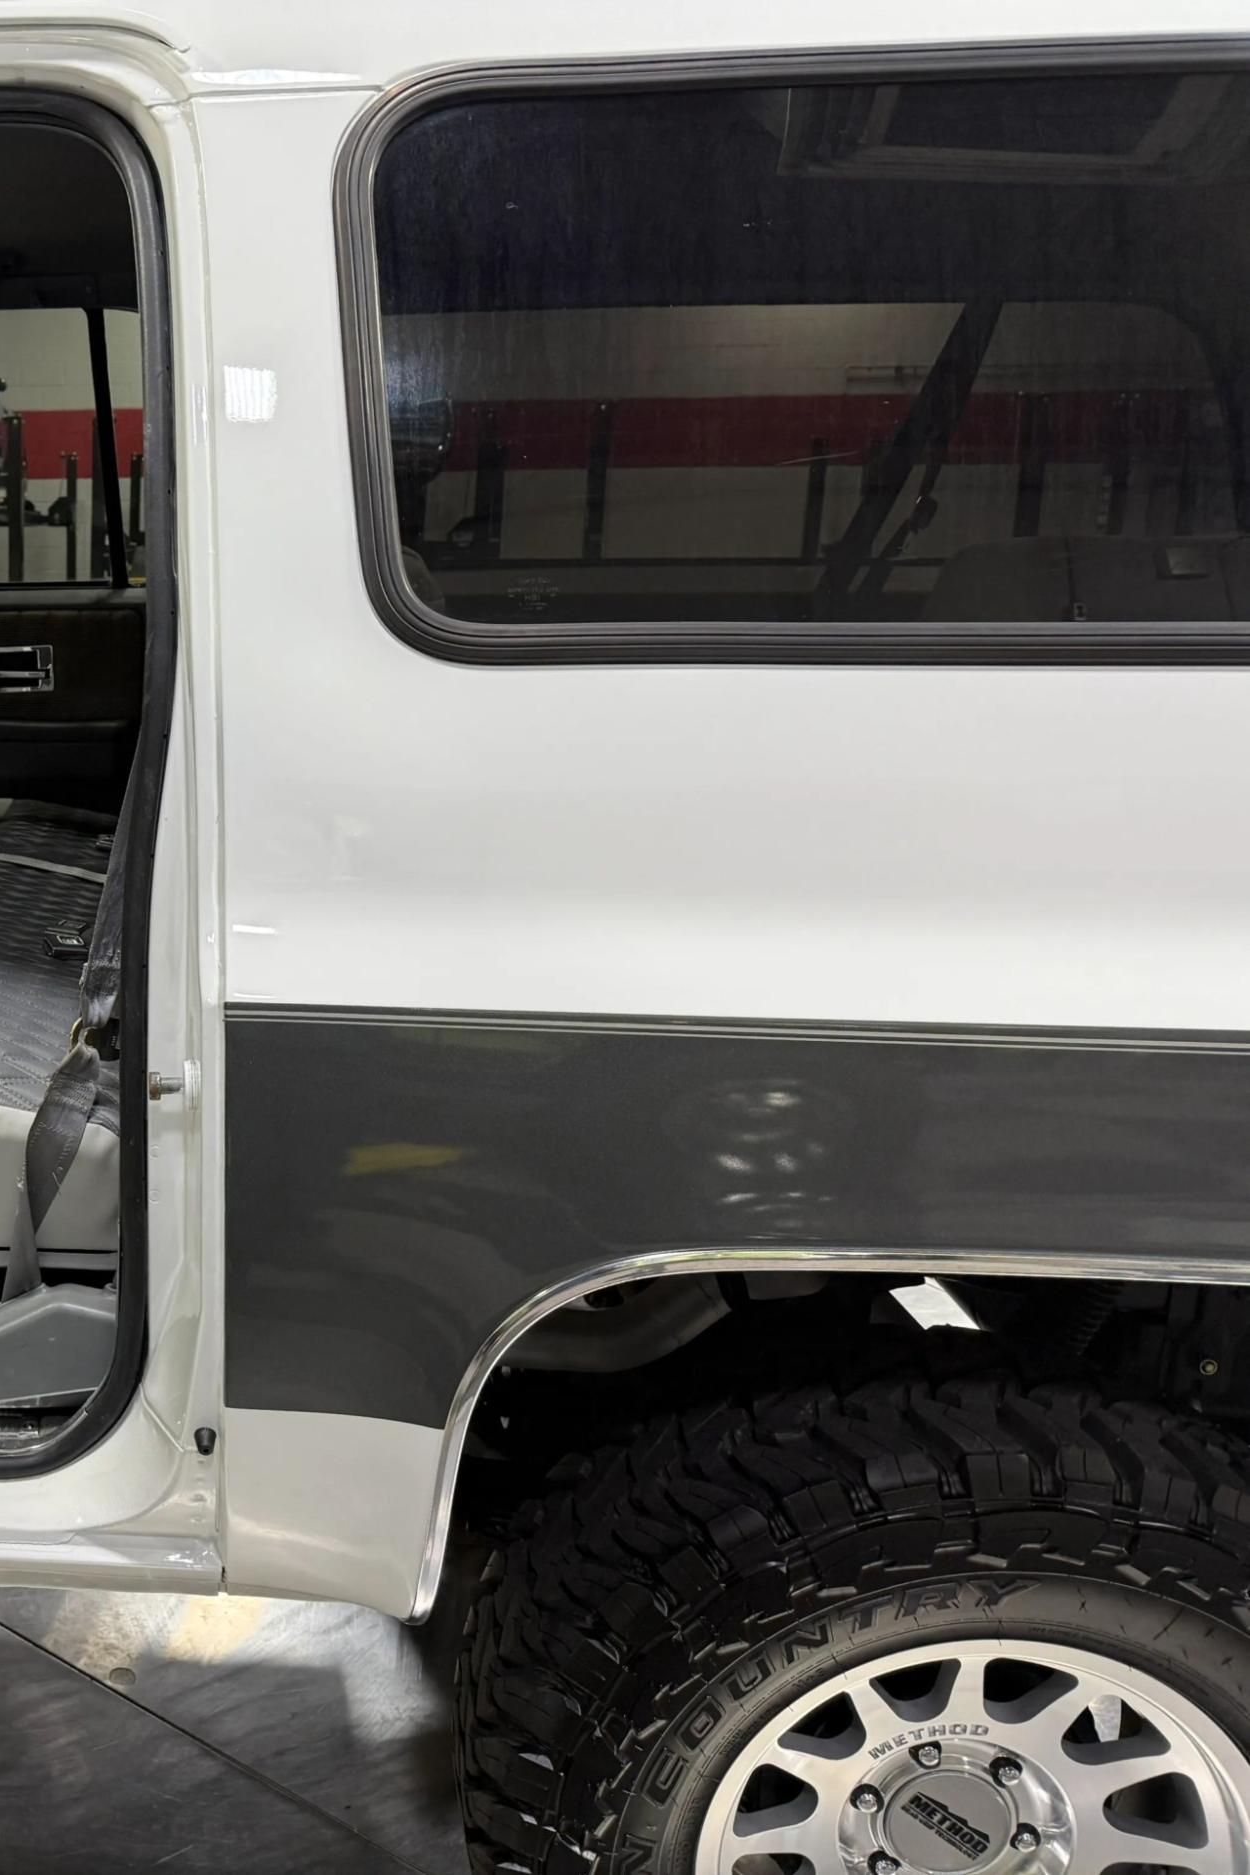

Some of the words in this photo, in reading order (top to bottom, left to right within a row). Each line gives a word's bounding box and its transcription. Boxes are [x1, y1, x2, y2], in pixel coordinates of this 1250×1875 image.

[642, 1578, 1042, 1809] COUNTRY
[868, 1723, 989, 1760] METHOD
[908, 1794, 989, 1854] METHOD
